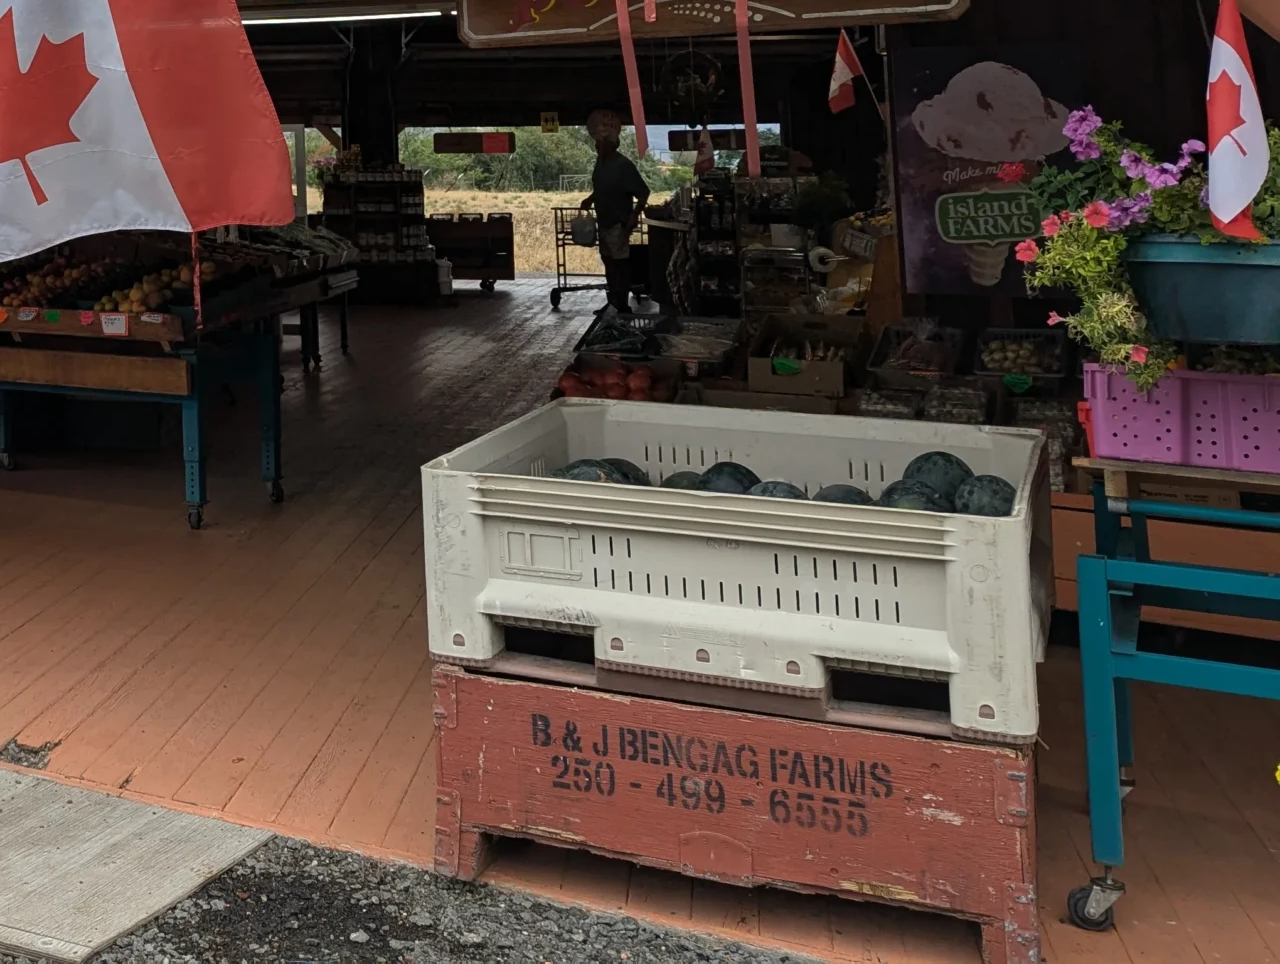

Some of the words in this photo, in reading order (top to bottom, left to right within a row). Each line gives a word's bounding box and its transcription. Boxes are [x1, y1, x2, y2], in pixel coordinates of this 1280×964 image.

[943, 163, 983, 185] Make
[948, 196, 1029, 219] island
[946, 215, 1036, 237] FARMS
[531, 713, 552, 747] B
[562, 720, 583, 752] &
[592, 724, 609, 757] J
[770, 748, 893, 799] FARMS
[551, 755, 616, 797] 250
[656, 773, 726, 815] 499
[769, 788, 870, 837] 6555
